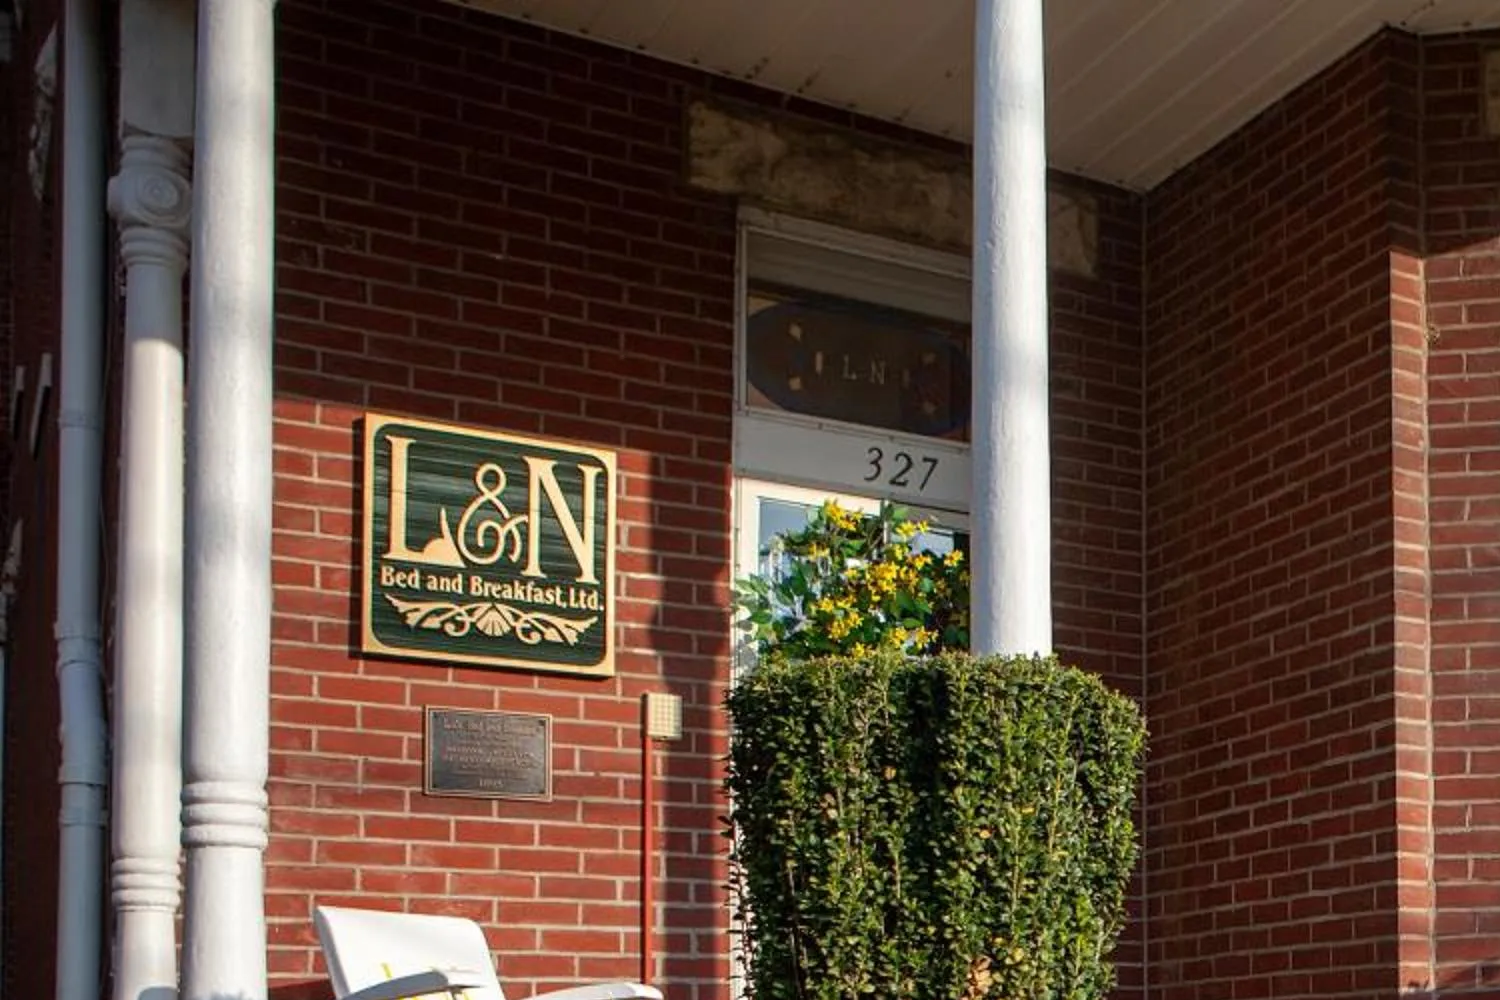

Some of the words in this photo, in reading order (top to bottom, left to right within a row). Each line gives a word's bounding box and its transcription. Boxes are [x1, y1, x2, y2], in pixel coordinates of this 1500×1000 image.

[863, 446, 939, 491] 327
[381, 434, 603, 585] L&N
[381, 565, 420, 590] Bed
[426, 573, 464, 594] and
[569, 586, 604, 611] Ltd.
